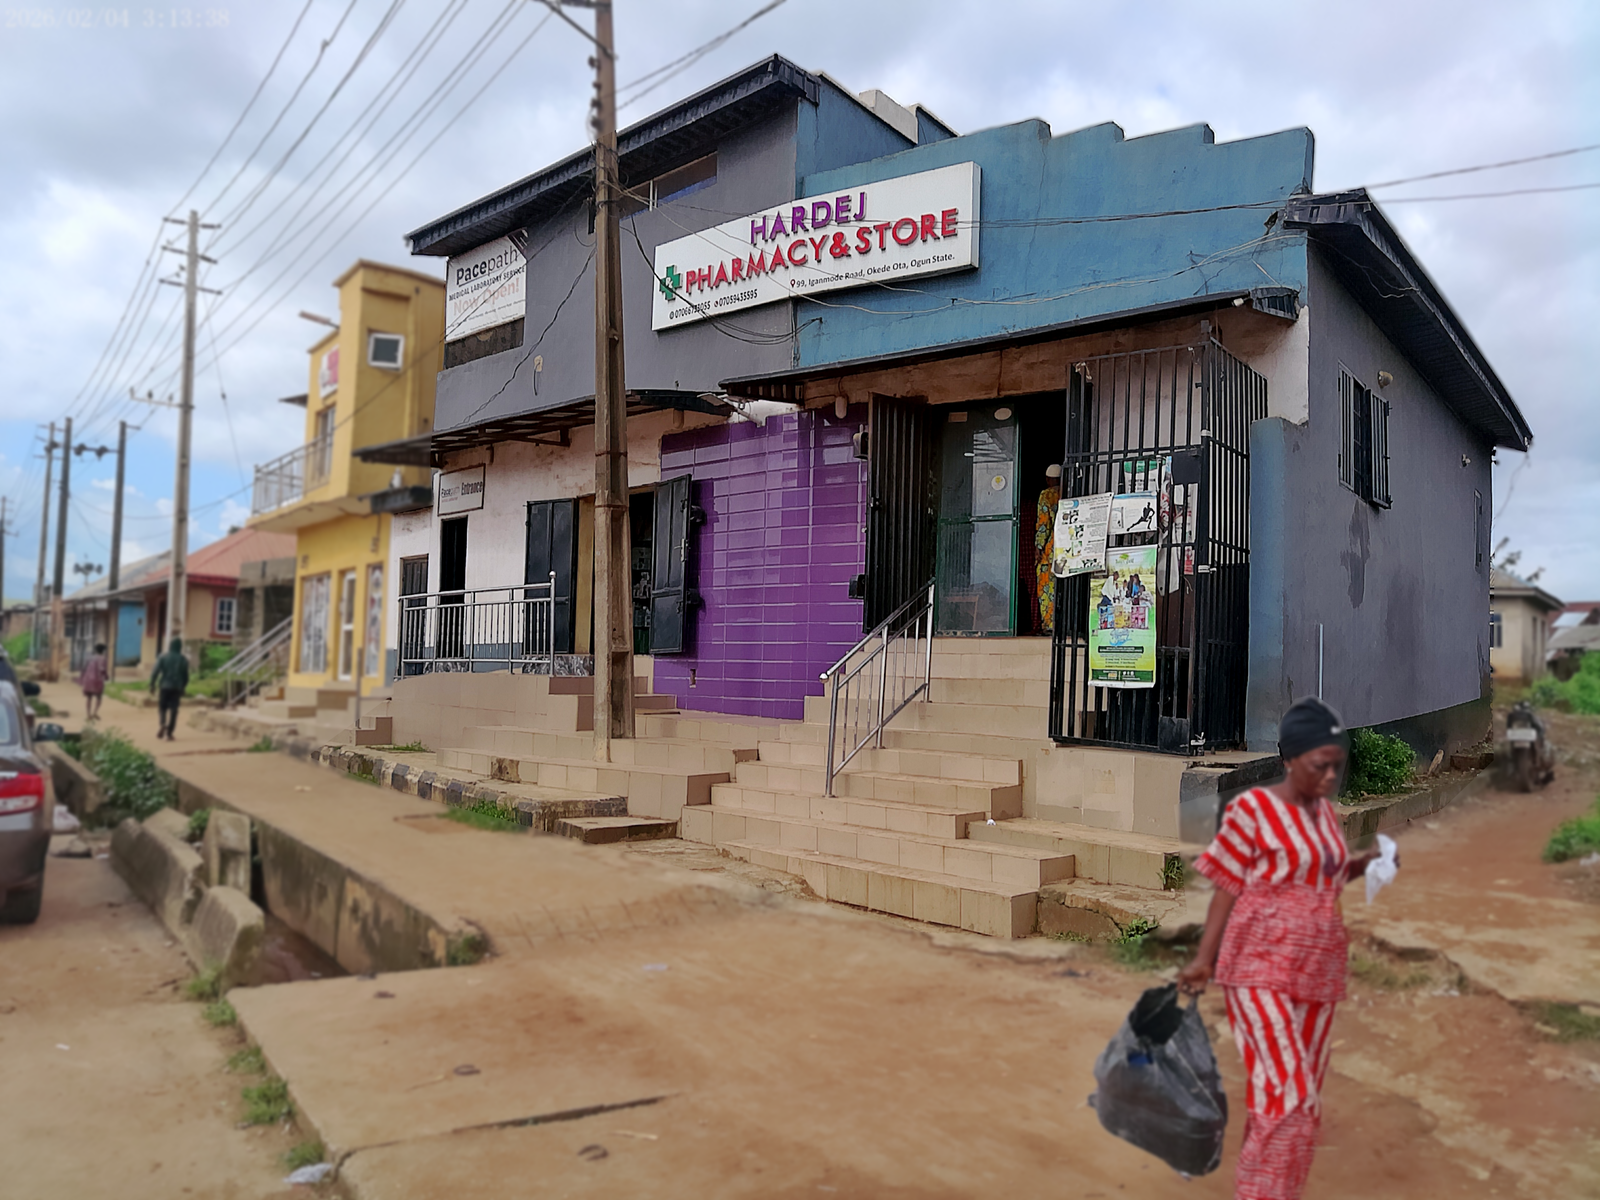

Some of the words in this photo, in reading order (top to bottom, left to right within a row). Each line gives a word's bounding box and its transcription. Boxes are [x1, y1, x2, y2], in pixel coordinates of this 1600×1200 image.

[750, 191, 867, 246] HARDEJ
[456, 244, 518, 286] Pacepath
[808, 273, 844, 287] Iganmode
[845, 269, 865, 280] Road,
[867, 264, 891, 276] Okede
[892, 262, 909, 271] Ota,
[910, 259, 931, 268] Ogun
[932, 253, 955, 264] State.
[449, 287, 470, 301] MEDICAL
[453, 295, 480, 316] Now
[483, 277, 520, 306] Open!
